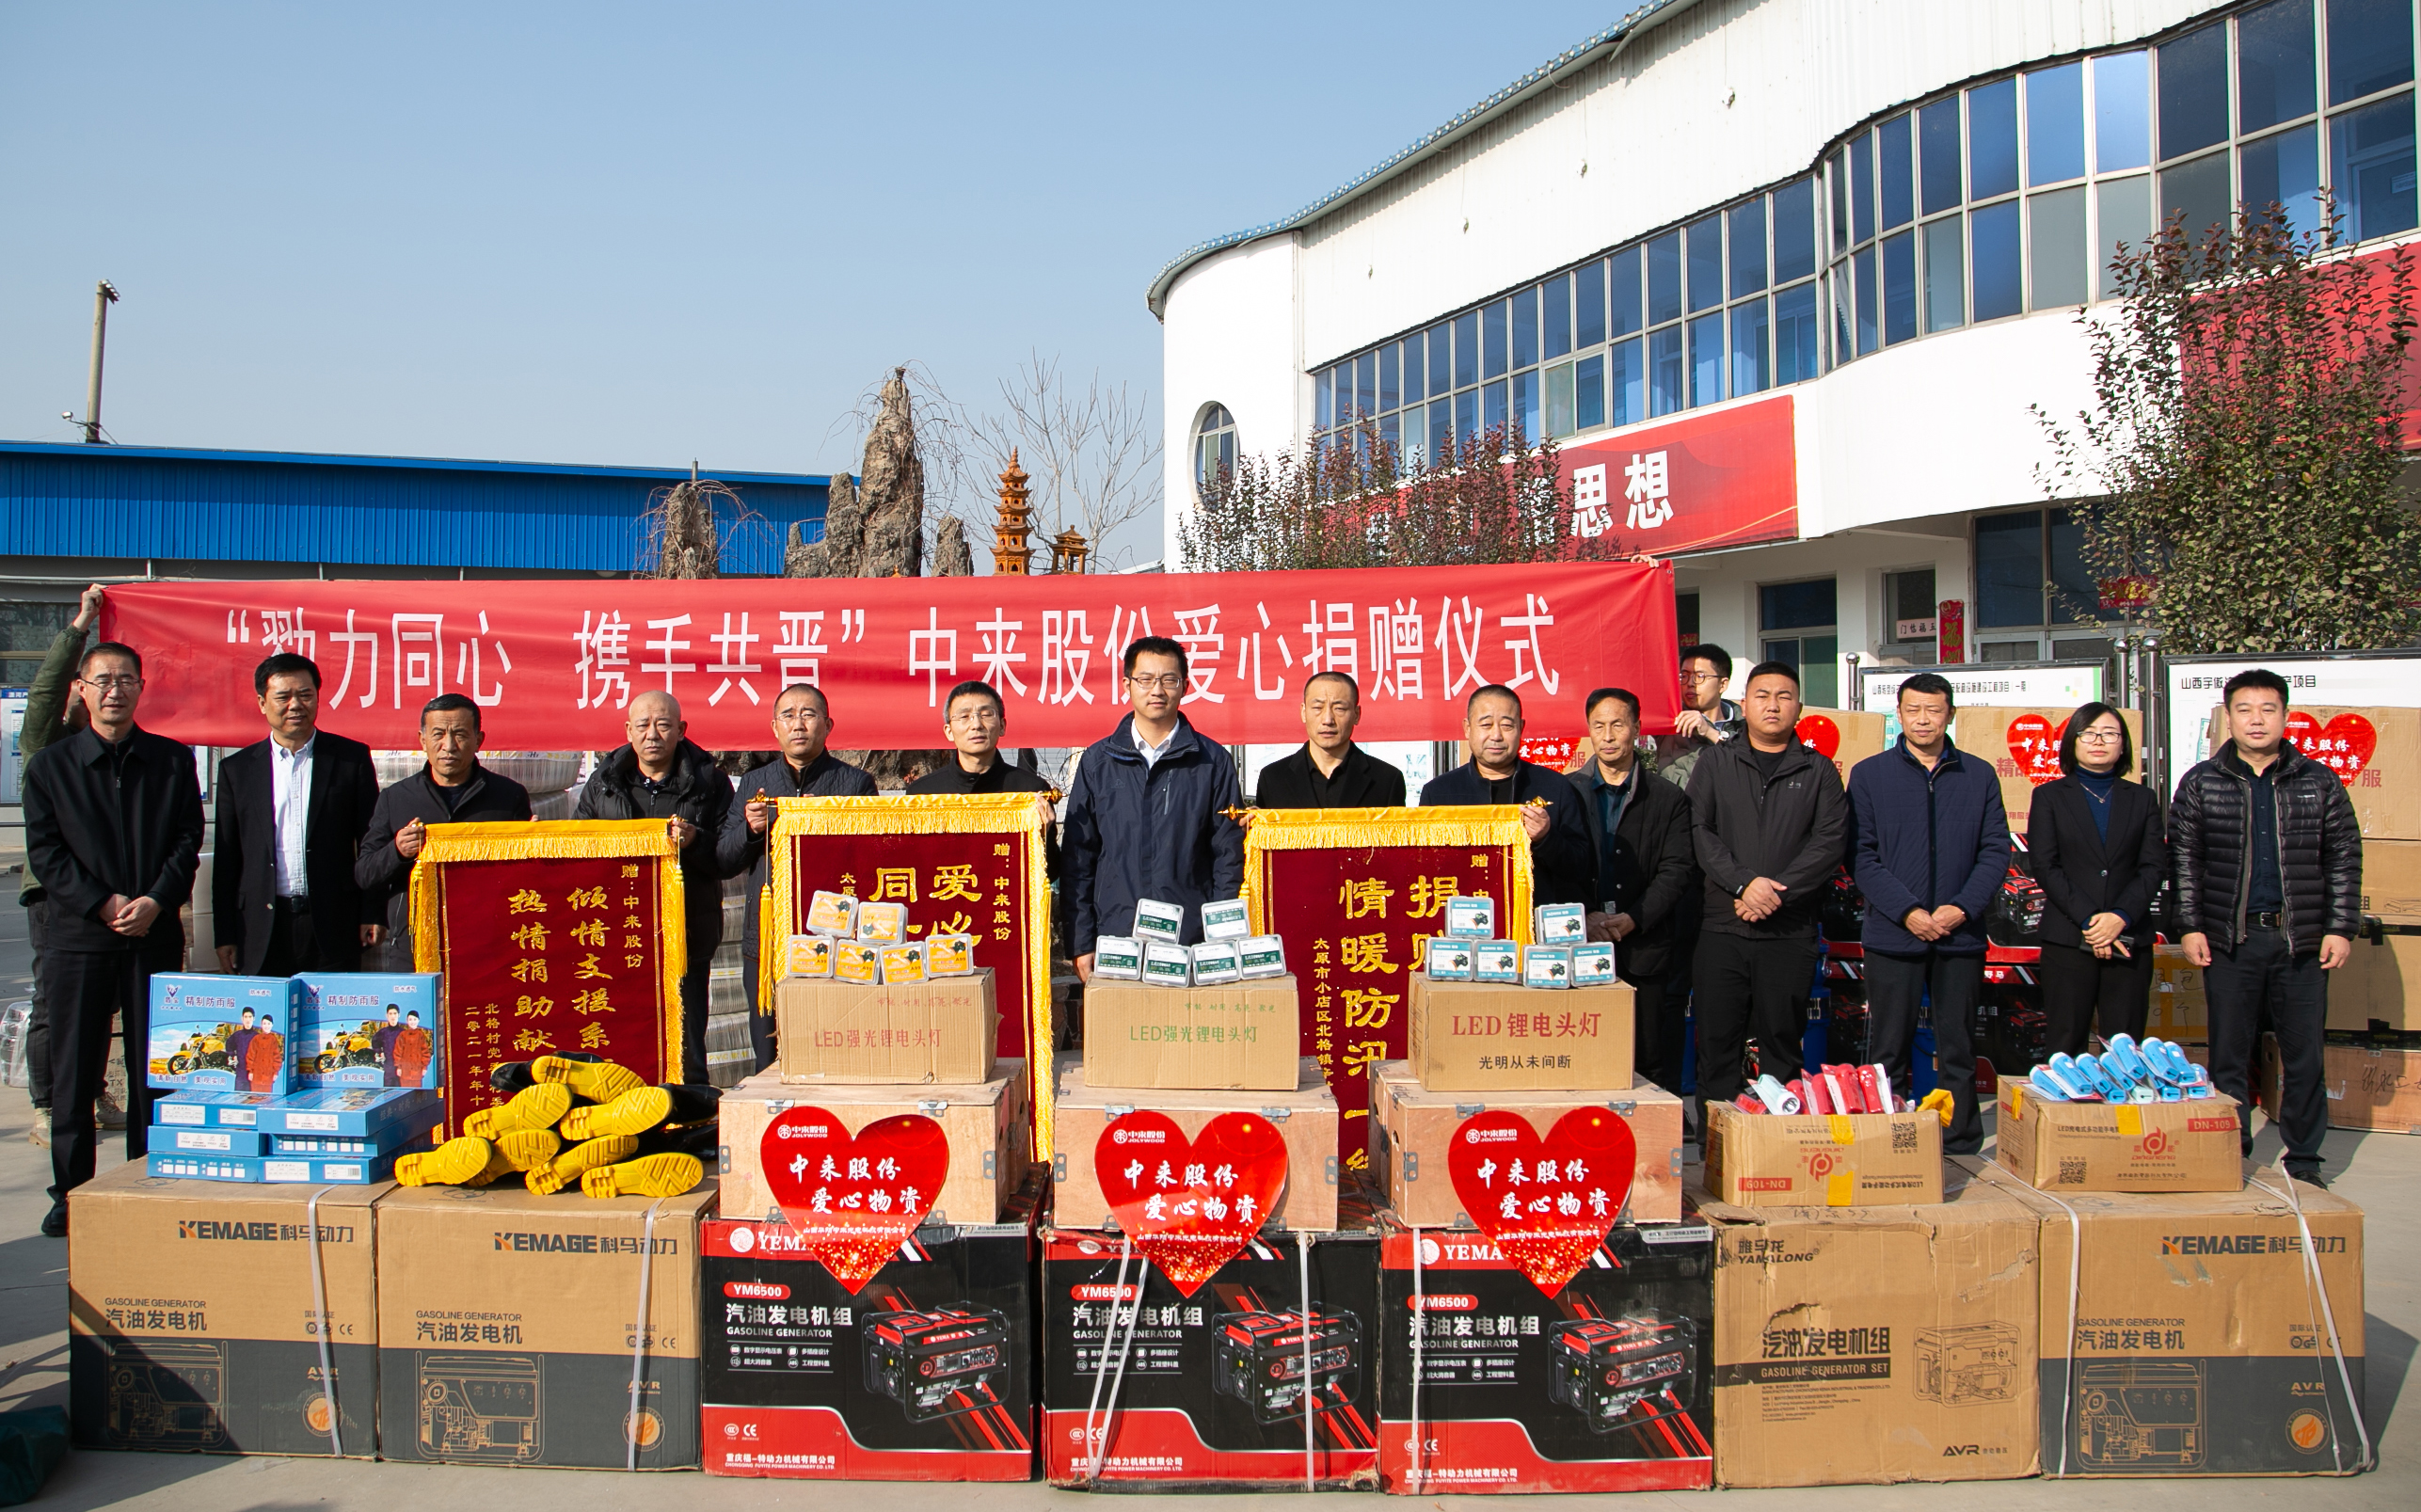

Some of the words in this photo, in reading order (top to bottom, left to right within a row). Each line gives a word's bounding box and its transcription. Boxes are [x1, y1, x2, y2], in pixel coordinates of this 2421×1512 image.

[1572, 450, 1674, 539] 思想
[1519, 743, 1571, 758] 爱心物资
[2302, 754, 2360, 769] 心物资
[840, 873, 857, 897] 太原
[993, 843, 1011, 941] 赠：中来股份
[621, 864, 644, 969] 赠：中来股份
[566, 886, 616, 1063] 倾情支援系
[186, 996, 235, 1008] 精制防雨服
[328, 995, 379, 1006] 精制防雨服
[815, 1029, 941, 1048] LED强光锂电头灯
[1130, 1026, 1258, 1042] LED强光锂电头灯
[1479, 1055, 1571, 1070] 光明从未间断
[1128, 1130, 1166, 1139] 中来股份
[1480, 1129, 1517, 1138] 中来股份
[2194, 1120, 2231, 1130] DN-109
[789, 1154, 901, 1184] 中来股份
[1124, 1159, 1239, 1190] 中来股份
[1477, 1158, 1590, 1189] 中来股份
[1746, 1179, 1786, 1189] DN-109
[811, 1186, 922, 1215] 爱心物资
[1144, 1193, 1258, 1224] 爱心物资
[1499, 1187, 1610, 1220] 爱心物资
[178, 1220, 278, 1241] KEMAGE
[280, 1225, 354, 1242] 科马动力
[494, 1232, 597, 1254] KEMAGE
[601, 1237, 677, 1255] 科马动力
[1444, 1245, 1504, 1261] YEMA
[2158, 1235, 2265, 1255] KEMAGE
[2268, 1236, 2346, 1254] 科马动力
[733, 1284, 782, 1297] YM6500
[105, 1297, 150, 1307] GASOLINE
[151, 1298, 207, 1308] GENERATOR
[105, 1309, 207, 1331] 汽油发电机
[416, 1311, 463, 1319] GASOLINE
[464, 1312, 522, 1322] GENERATOR
[726, 1303, 853, 1326] 汽油发电机组
[1073, 1306, 1203, 1327] 汽油发电机组
[2077, 1318, 2124, 1327] GASOLINE
[2126, 1318, 2185, 1327] GENERATOR
[417, 1322, 523, 1345] 汽油发电机
[726, 1327, 773, 1337] GASOLINE
[776, 1328, 833, 1338] GENERATOR
[1073, 1330, 1122, 1339] GASOLNE
[1409, 1315, 1540, 1336] 汽油发电机组
[1461, 1339, 1519, 1348] GENERATOR
[1762, 1327, 1891, 1358] 汽油发电机组
[2077, 1329, 2185, 1350] 汽油发电机
[1761, 1366, 1809, 1378] GASOLINE
[1812, 1364, 1867, 1376] GENERATOR
[1871, 1363, 1889, 1373] SET
[2291, 1382, 2325, 1390] AVR
[1943, 1445, 1980, 1456] AVR
